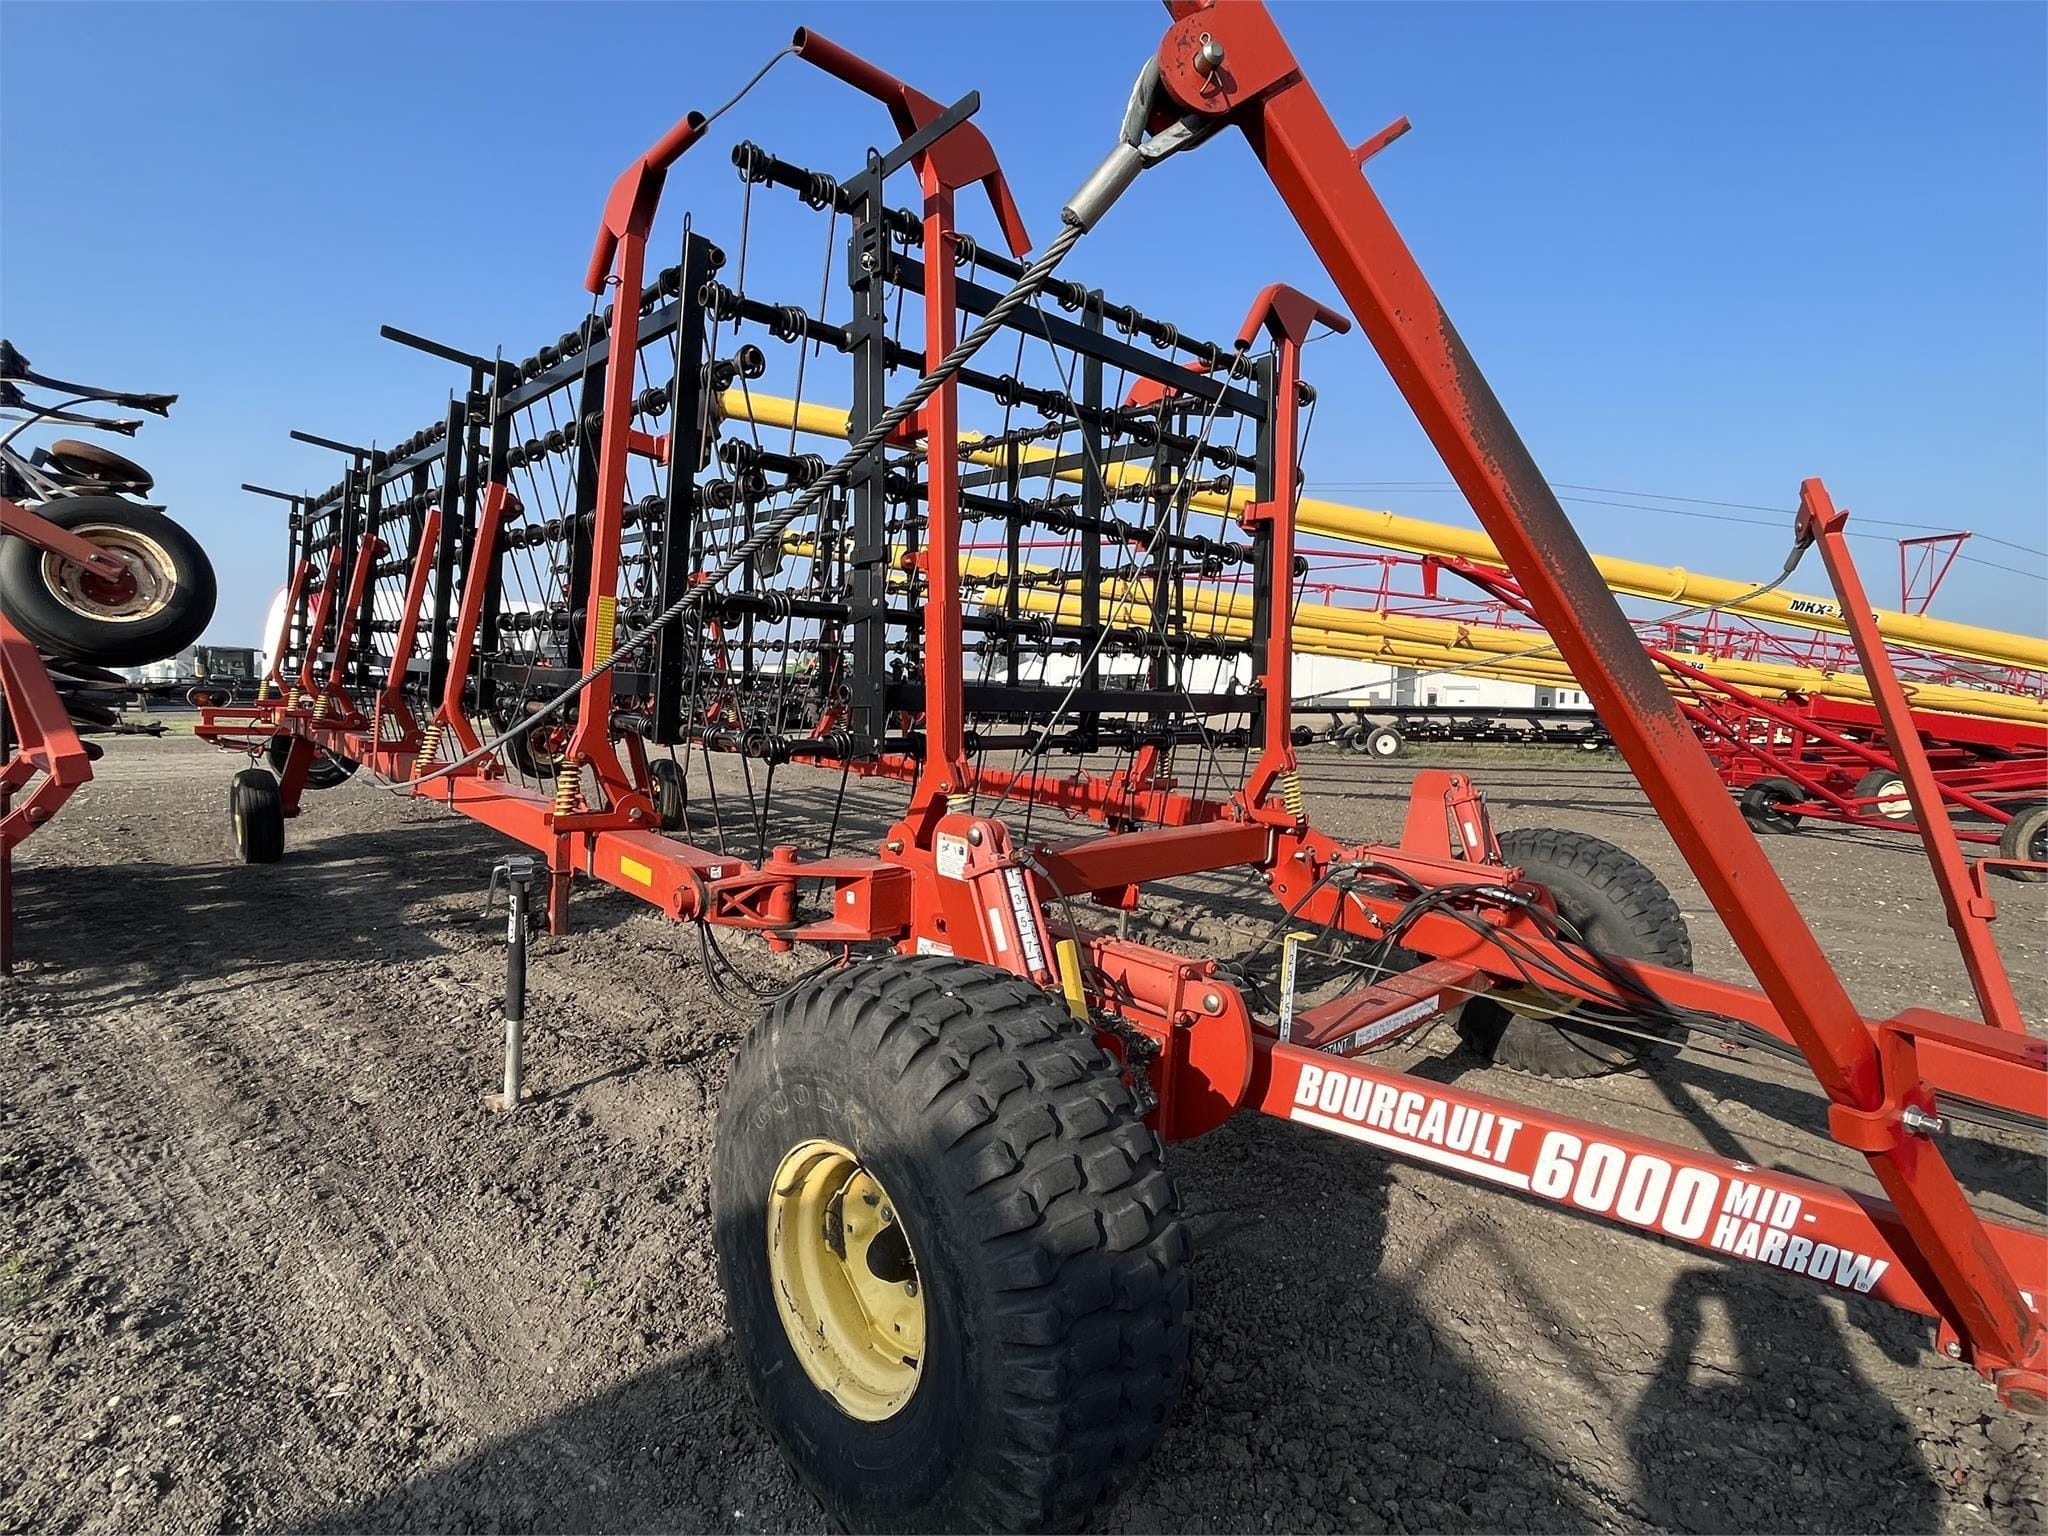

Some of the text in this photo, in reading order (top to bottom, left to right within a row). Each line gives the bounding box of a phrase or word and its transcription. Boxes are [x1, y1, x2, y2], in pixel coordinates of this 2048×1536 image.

[1014, 894, 1022, 905] 3
[1020, 917, 1028, 928] 5
[1294, 1063, 1721, 1240] BOURGAULT 6000
[1721, 1179, 1817, 1231] MID-
[1710, 1213, 1890, 1294] HARROW
